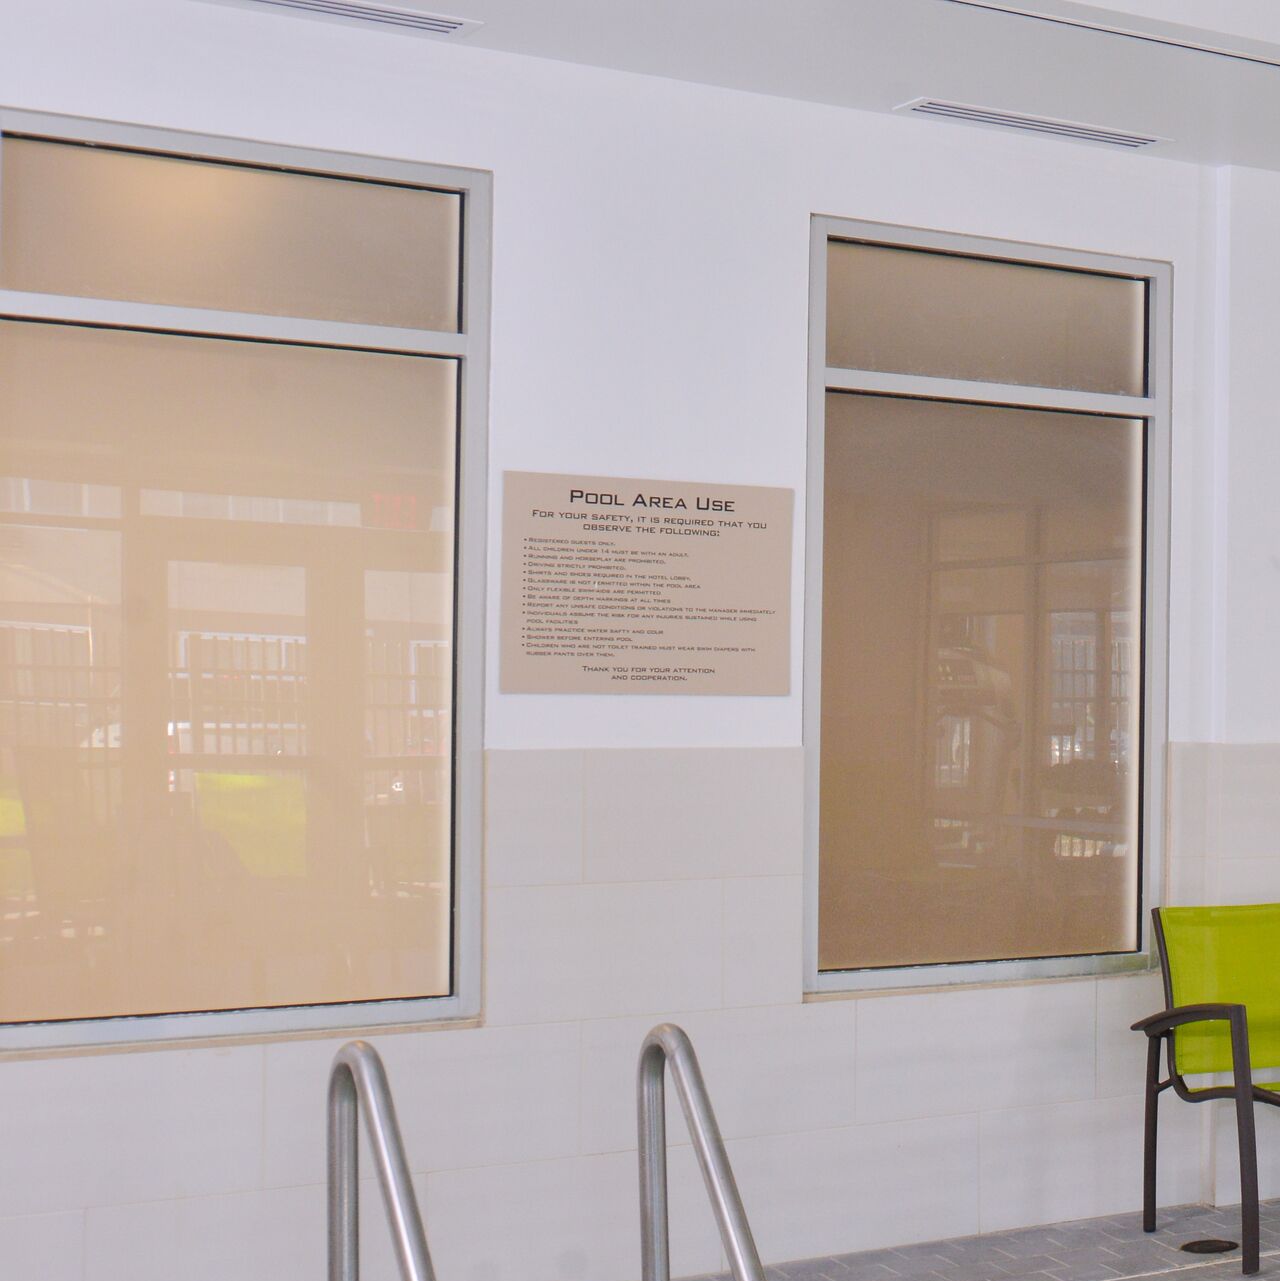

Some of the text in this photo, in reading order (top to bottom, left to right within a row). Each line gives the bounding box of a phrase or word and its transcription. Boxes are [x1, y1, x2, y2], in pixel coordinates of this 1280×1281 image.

[570, 490, 735, 512] POOL AREA USE
[532, 509, 554, 518] FOR
[592, 514, 633, 522] SAFETY,
[664, 518, 714, 526] REQUIRED
[583, 524, 632, 532] OBSERVE
[660, 527, 720, 537] FOLLOWING:
